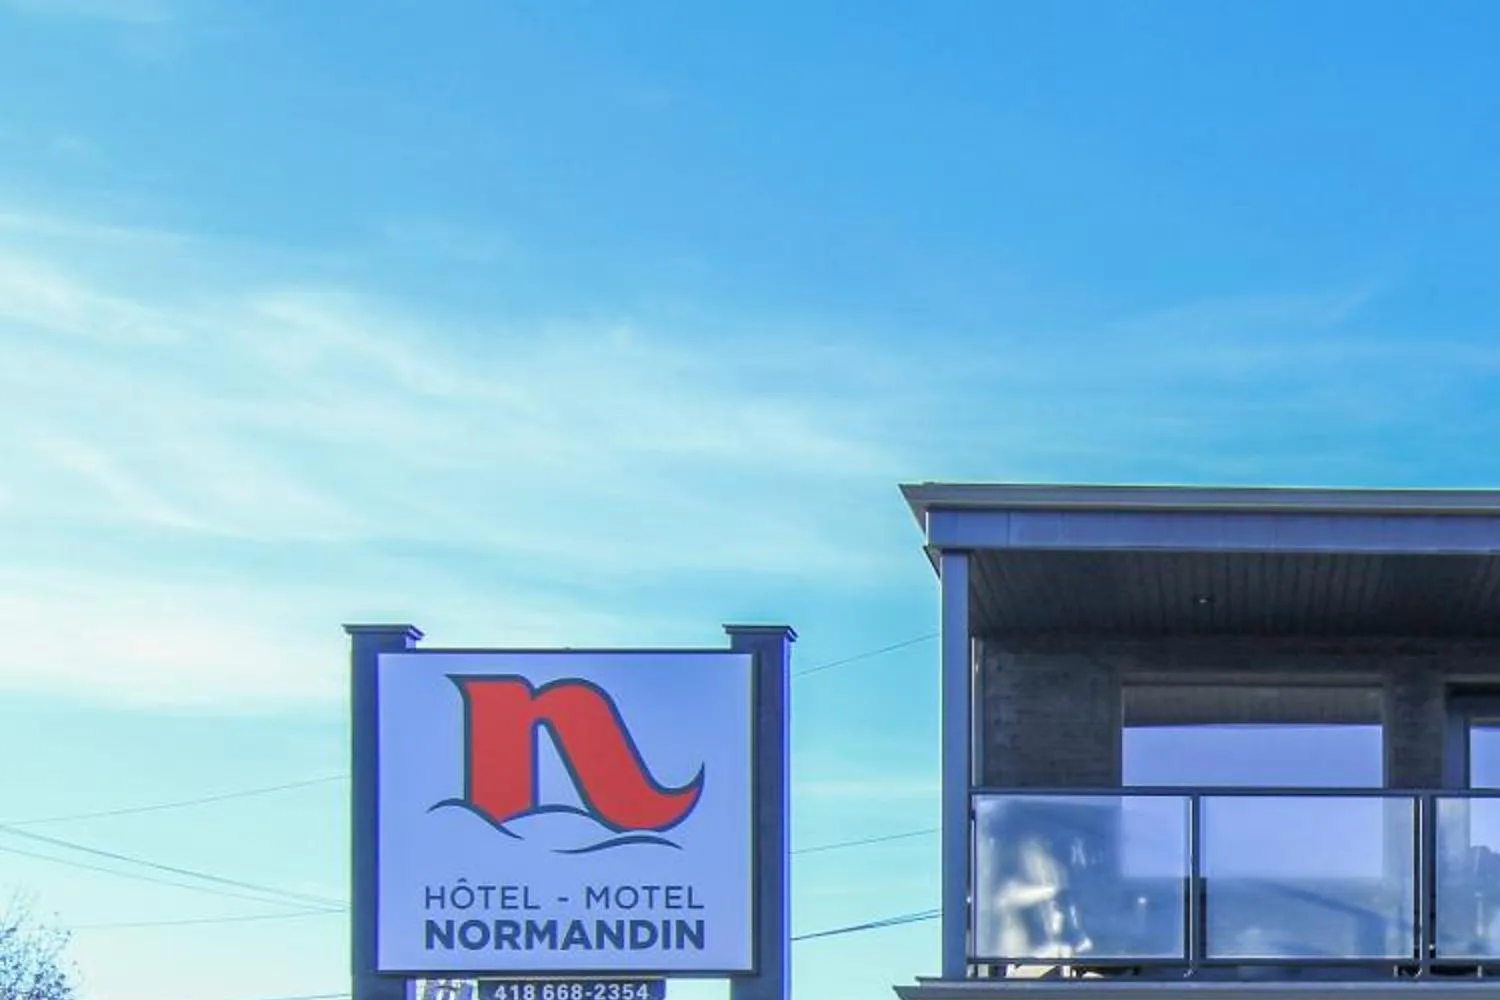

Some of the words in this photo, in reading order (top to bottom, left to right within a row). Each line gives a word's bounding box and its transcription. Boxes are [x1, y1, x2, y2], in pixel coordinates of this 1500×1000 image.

[425, 878, 541, 909] HÔTEL
[585, 885, 705, 909] MOTEL
[425, 919, 705, 950] NORMANDIN
[494, 984, 535, 1000] 418
[543, 984, 650, 1000] 668-2354
